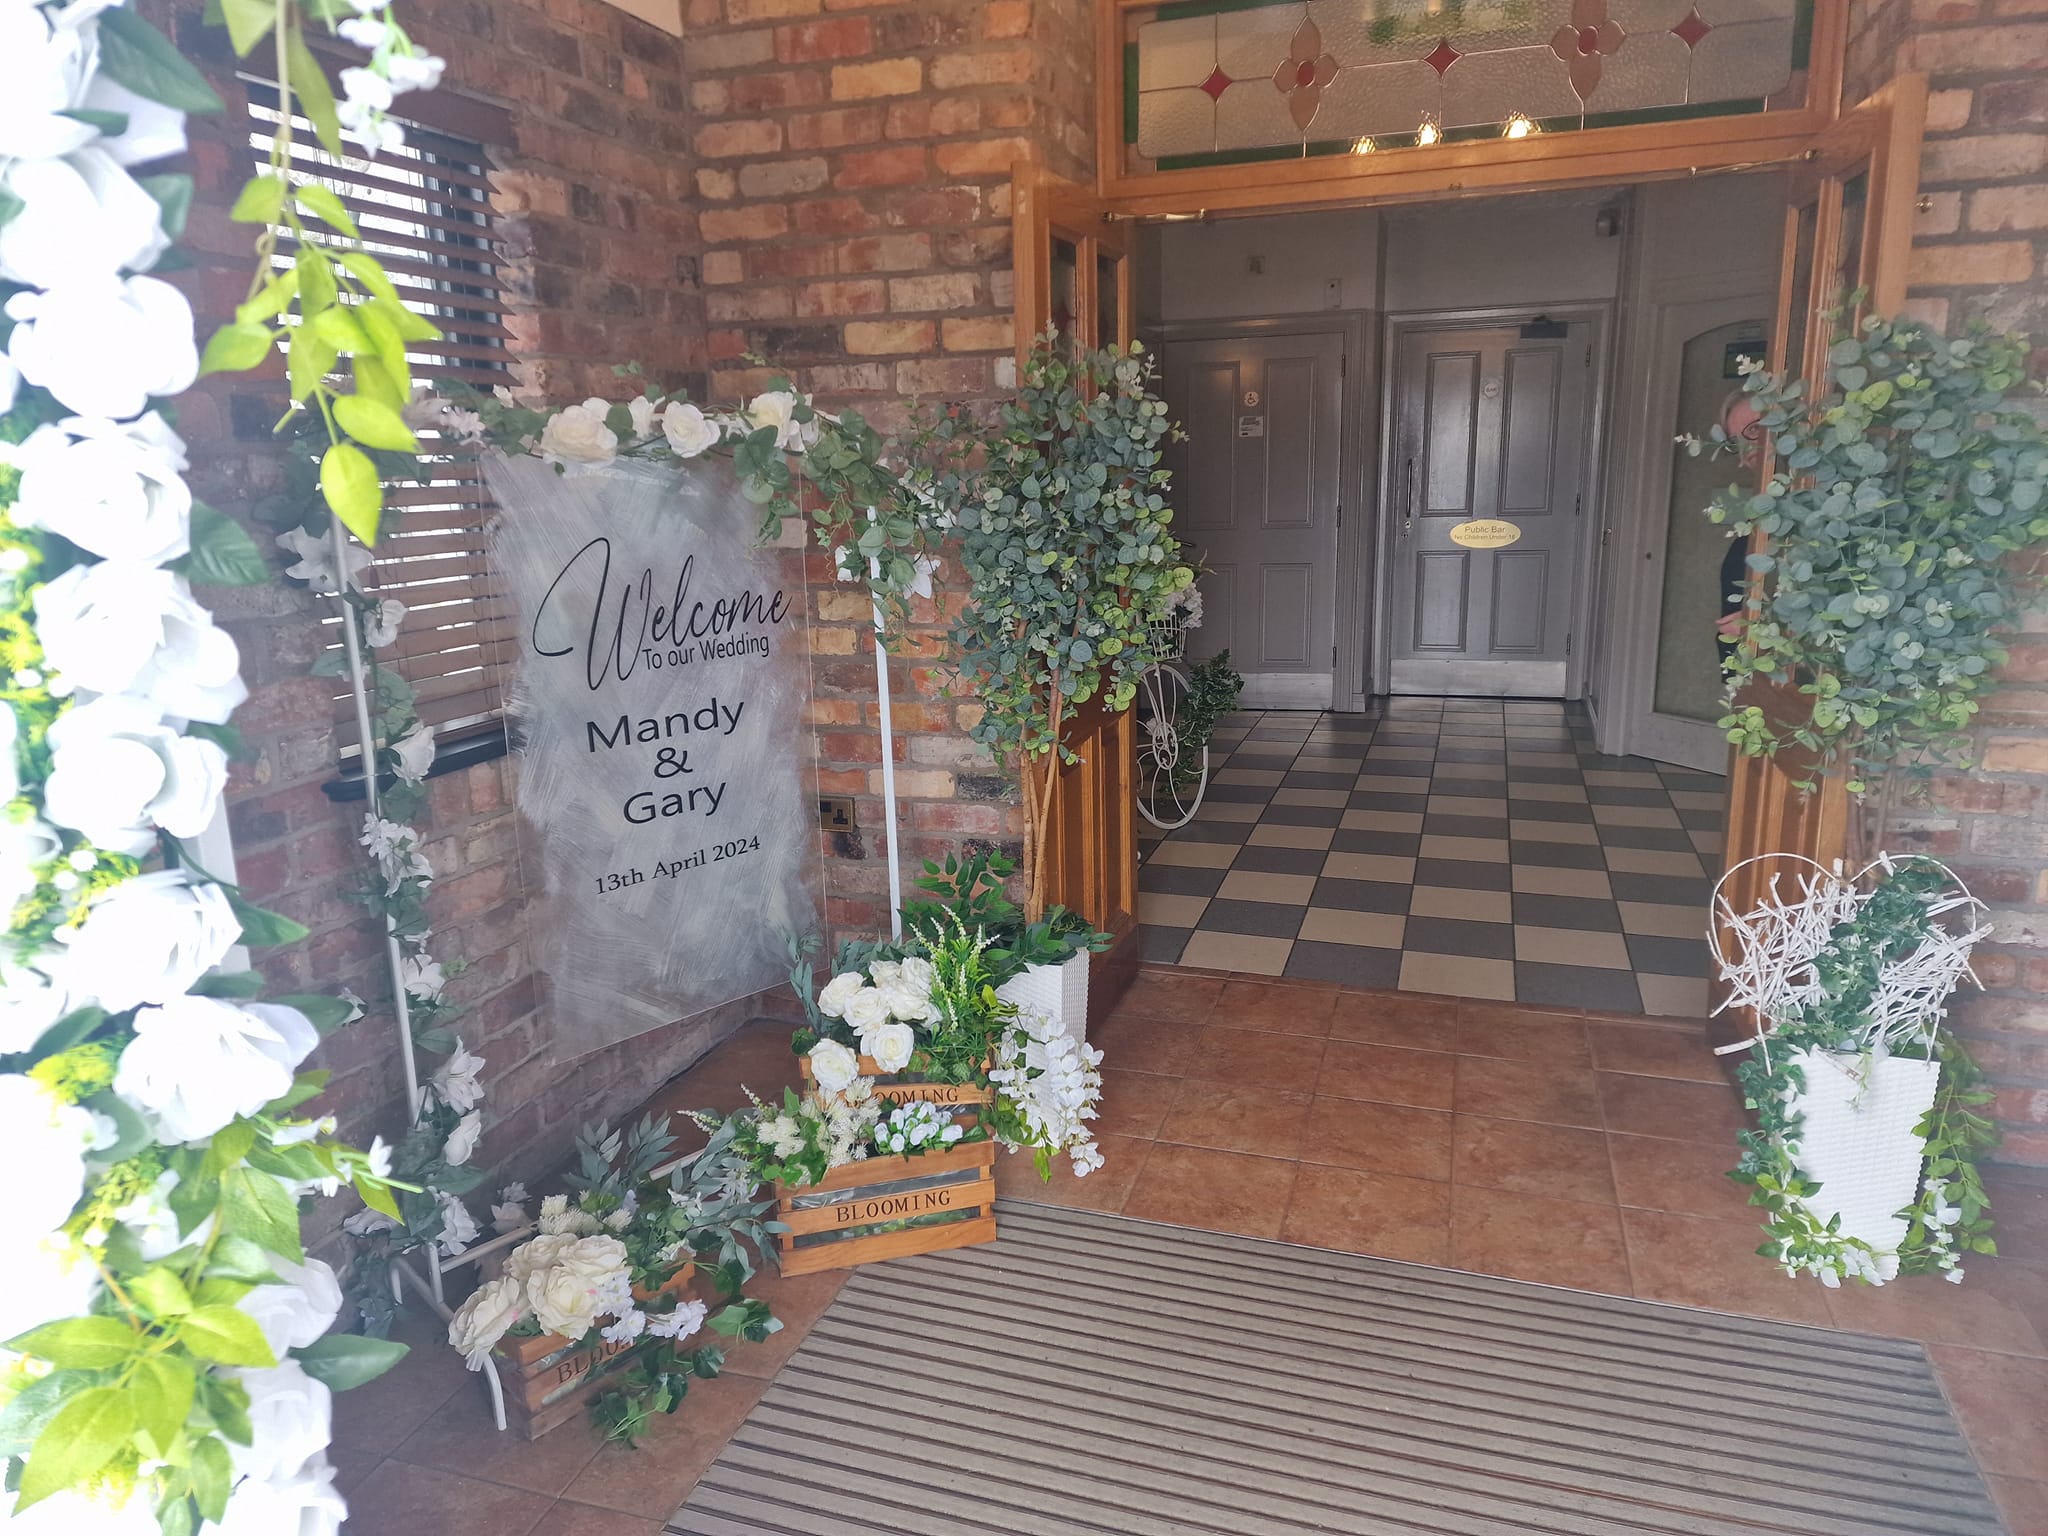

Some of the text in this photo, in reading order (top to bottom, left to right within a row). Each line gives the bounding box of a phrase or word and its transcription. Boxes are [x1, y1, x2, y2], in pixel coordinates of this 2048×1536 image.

[1464, 526, 1489, 534] Public
[532, 537, 793, 690] Welcome
[642, 632, 770, 670] To our Wedding
[586, 697, 744, 753] Mandy
[653, 747, 693, 779] &
[623, 782, 726, 824] Gary
[596, 835, 761, 895] 13th April 2024
[836, 1190, 951, 1222] BLOOMING
